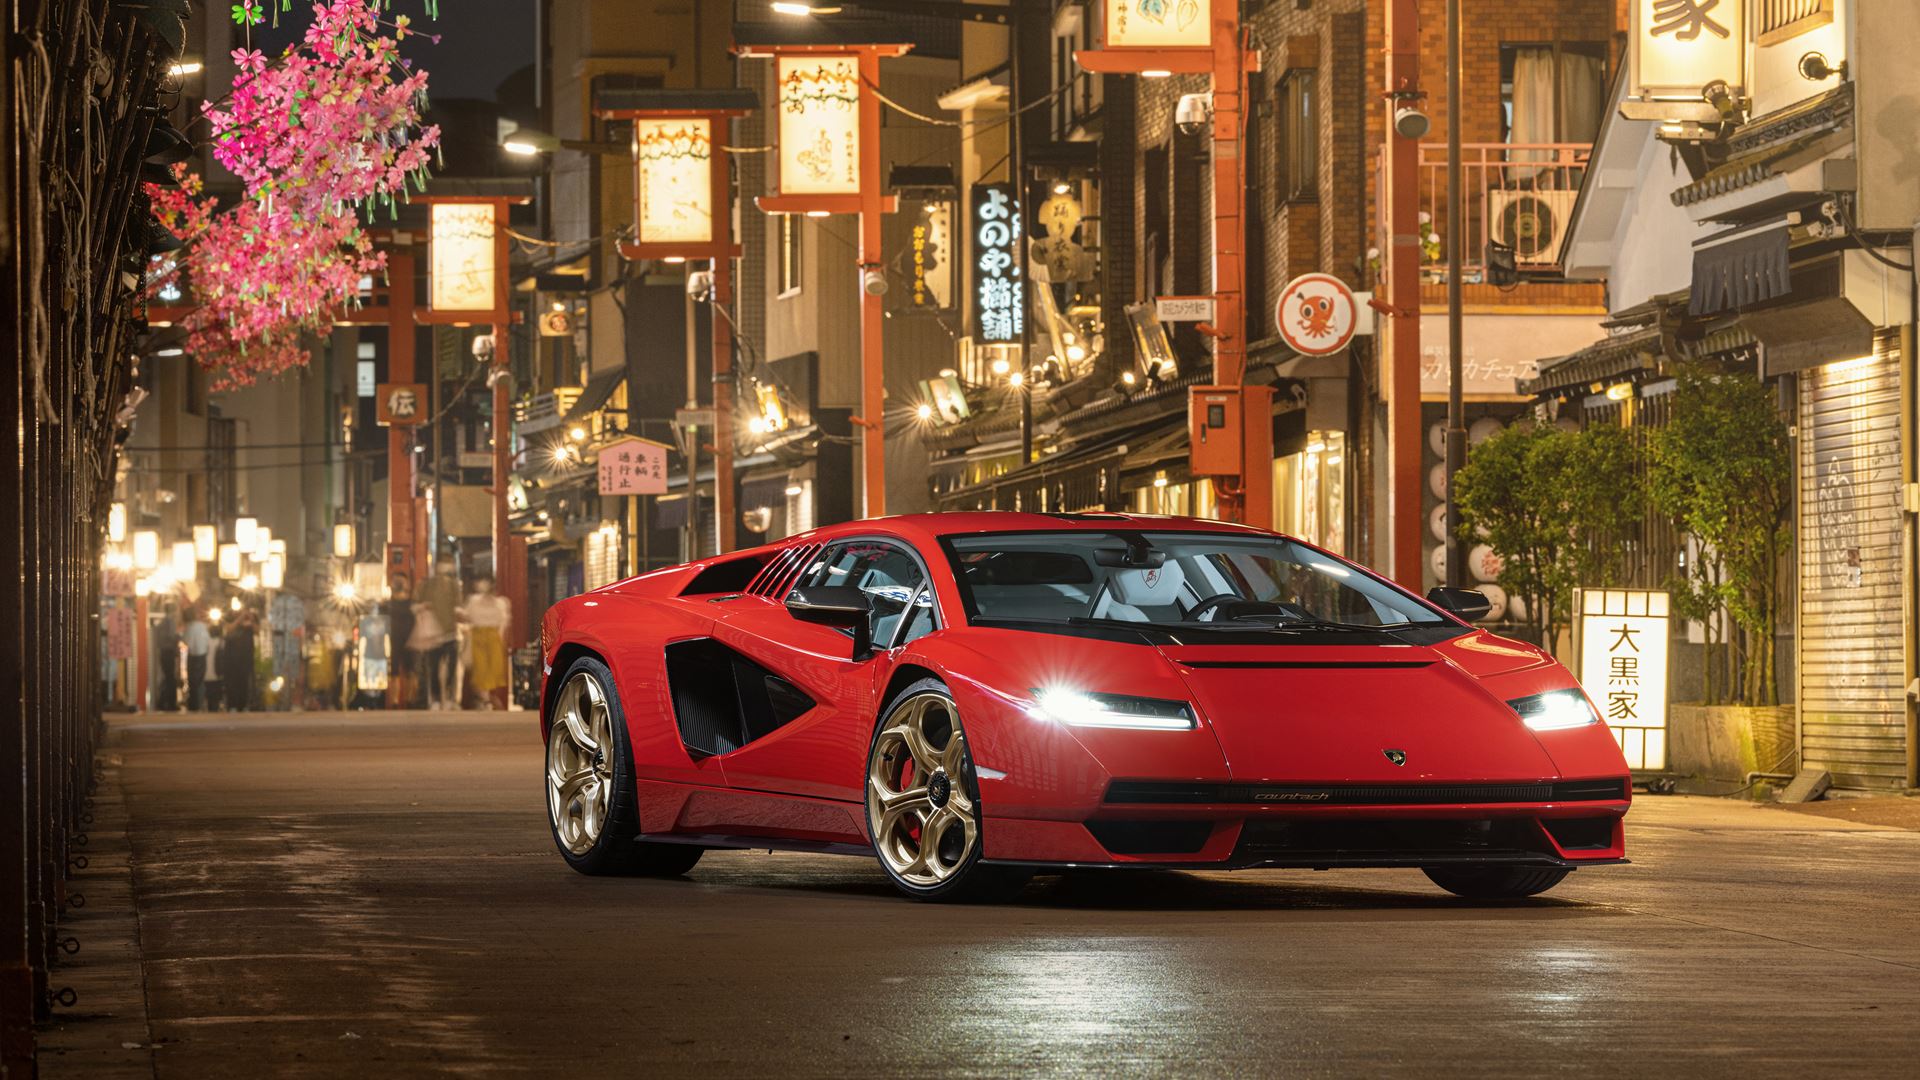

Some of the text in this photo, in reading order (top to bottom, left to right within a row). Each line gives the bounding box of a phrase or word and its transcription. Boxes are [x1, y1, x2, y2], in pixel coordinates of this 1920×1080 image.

[1609, 623, 1641, 719] 大黒家
[1254, 792, 1329, 801] countach
